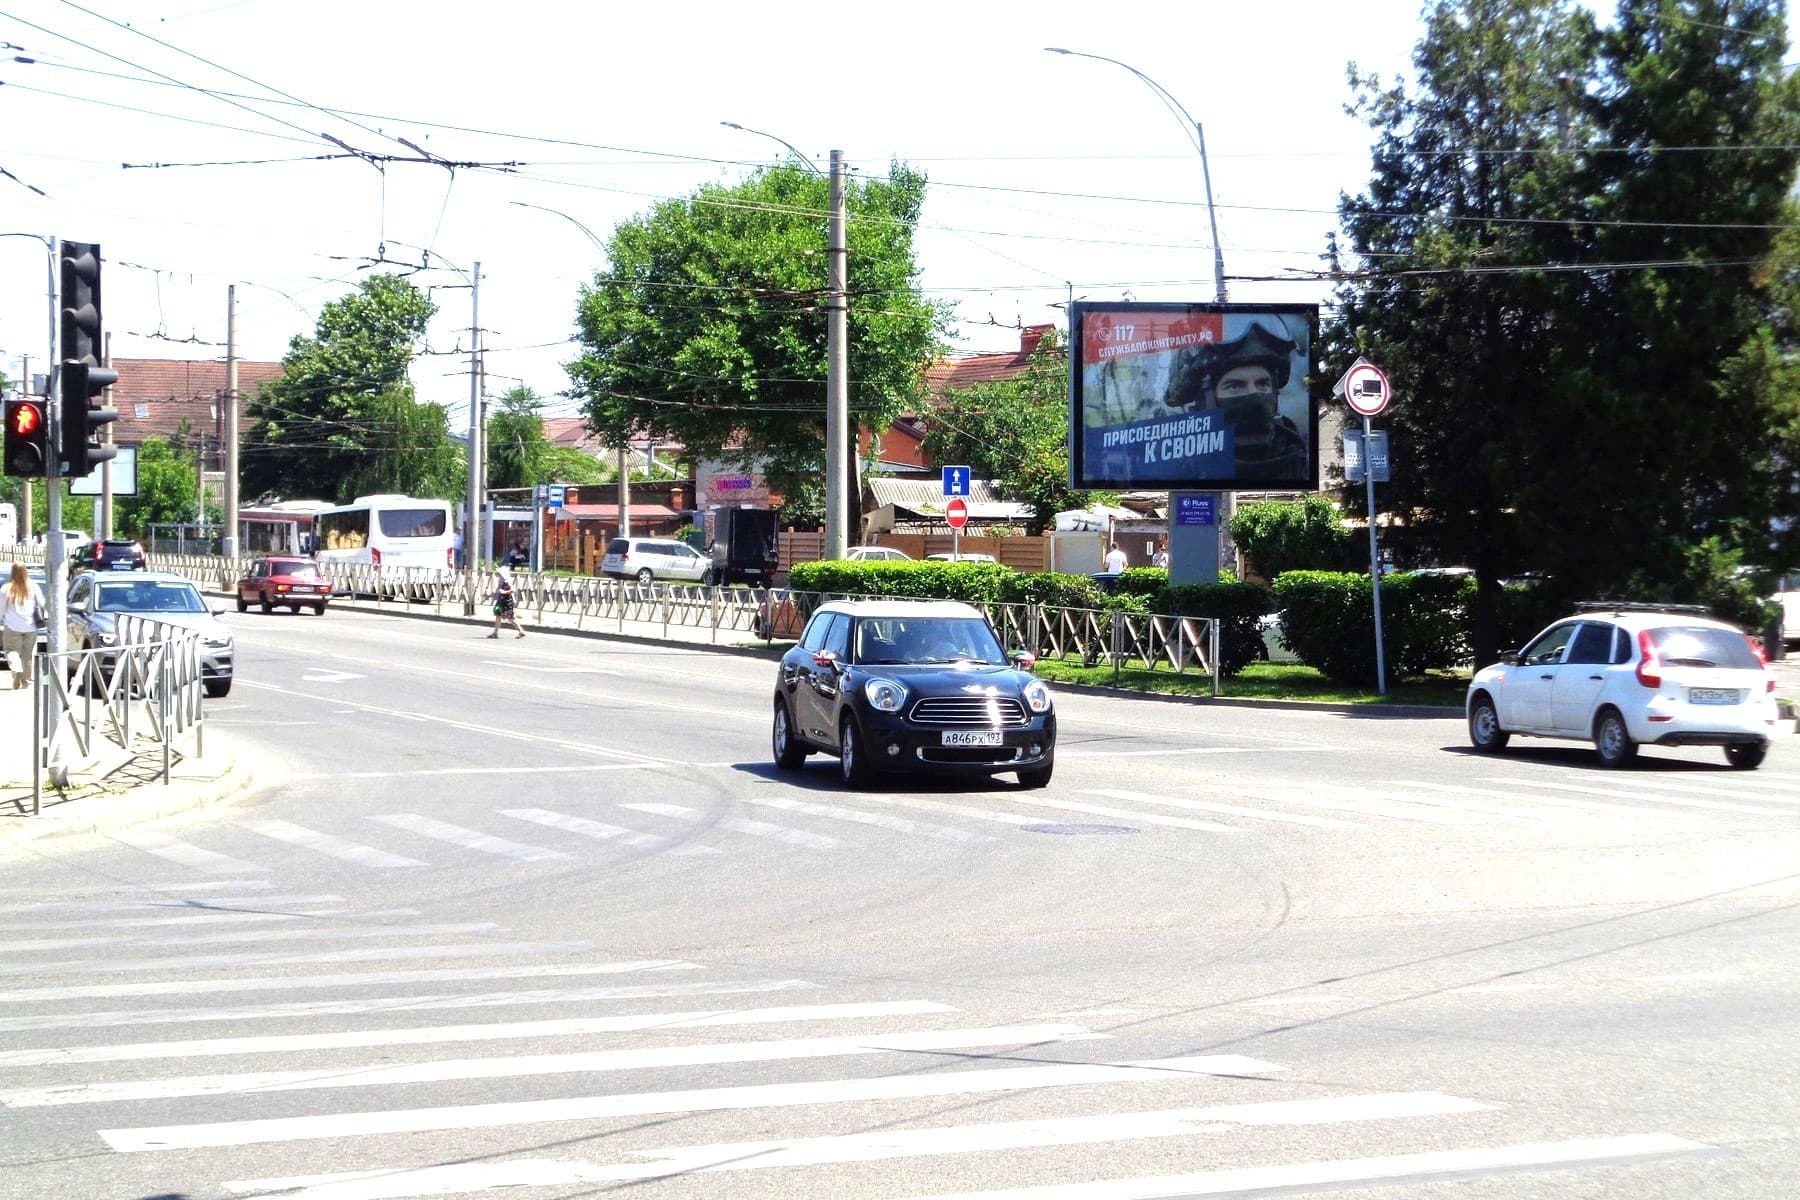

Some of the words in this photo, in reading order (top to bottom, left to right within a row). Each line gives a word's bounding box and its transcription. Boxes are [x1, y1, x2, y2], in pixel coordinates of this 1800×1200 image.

[1114, 325, 1135, 341] 117
[1103, 416, 1211, 448] ПРИСОЕДИНЯЙСЯ
[1144, 441, 1157, 464] К
[1161, 430, 1225, 461] СВОИМ
